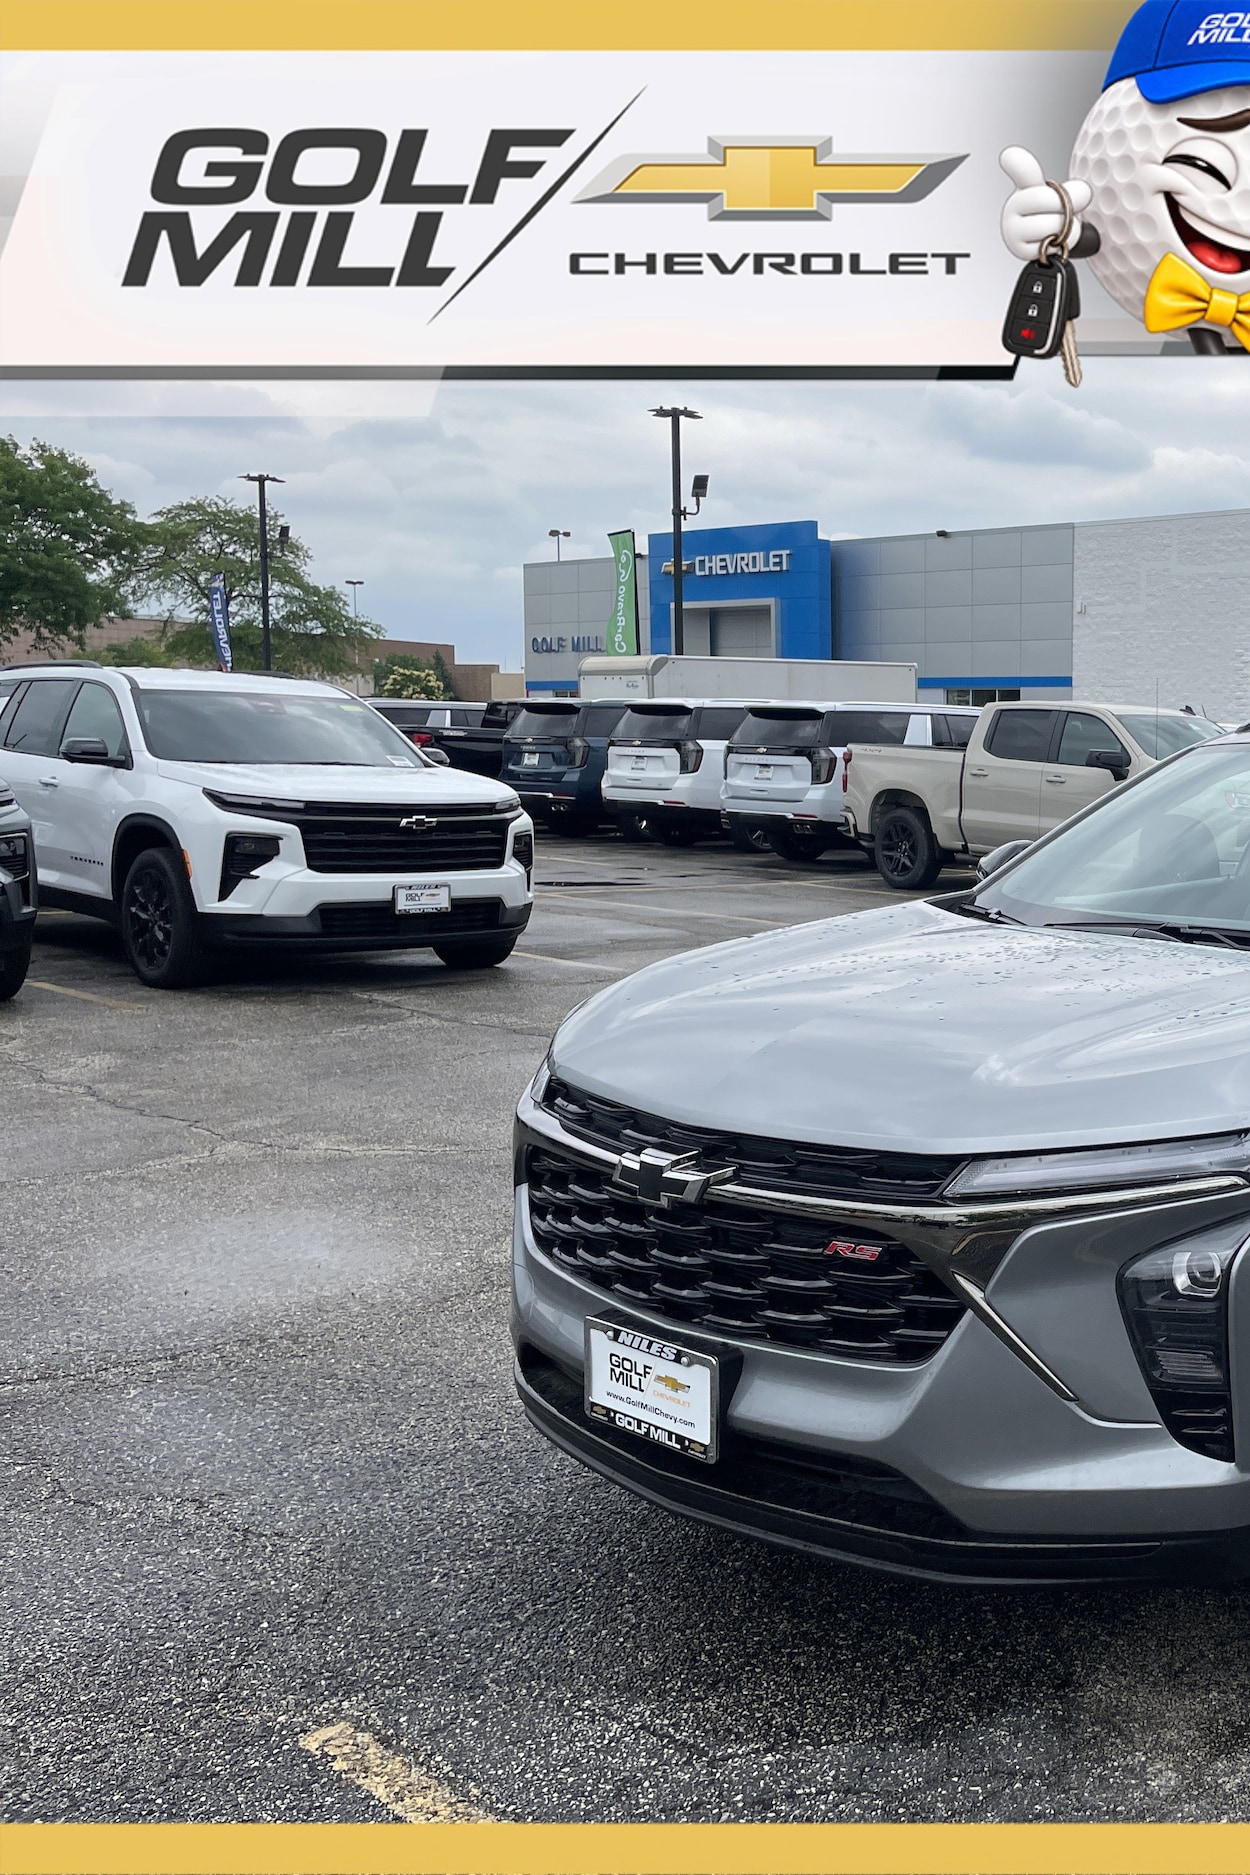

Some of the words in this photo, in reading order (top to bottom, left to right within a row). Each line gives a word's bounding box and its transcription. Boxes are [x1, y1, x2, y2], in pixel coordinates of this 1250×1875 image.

[694, 549, 791, 577] CHEVROLET
[531, 636, 567, 654] GOLF
[571, 635, 606, 653] MILL
[823, 1240, 882, 1260] RS
[617, 1331, 678, 1361] NILES
[609, 1352, 653, 1379] GOLF
[609, 1367, 645, 1393] MILL
[606, 1390, 695, 1429] www.GolfMillChevy.com
[615, 1413, 649, 1436] GOLF
[649, 1425, 681, 1449] MILL
